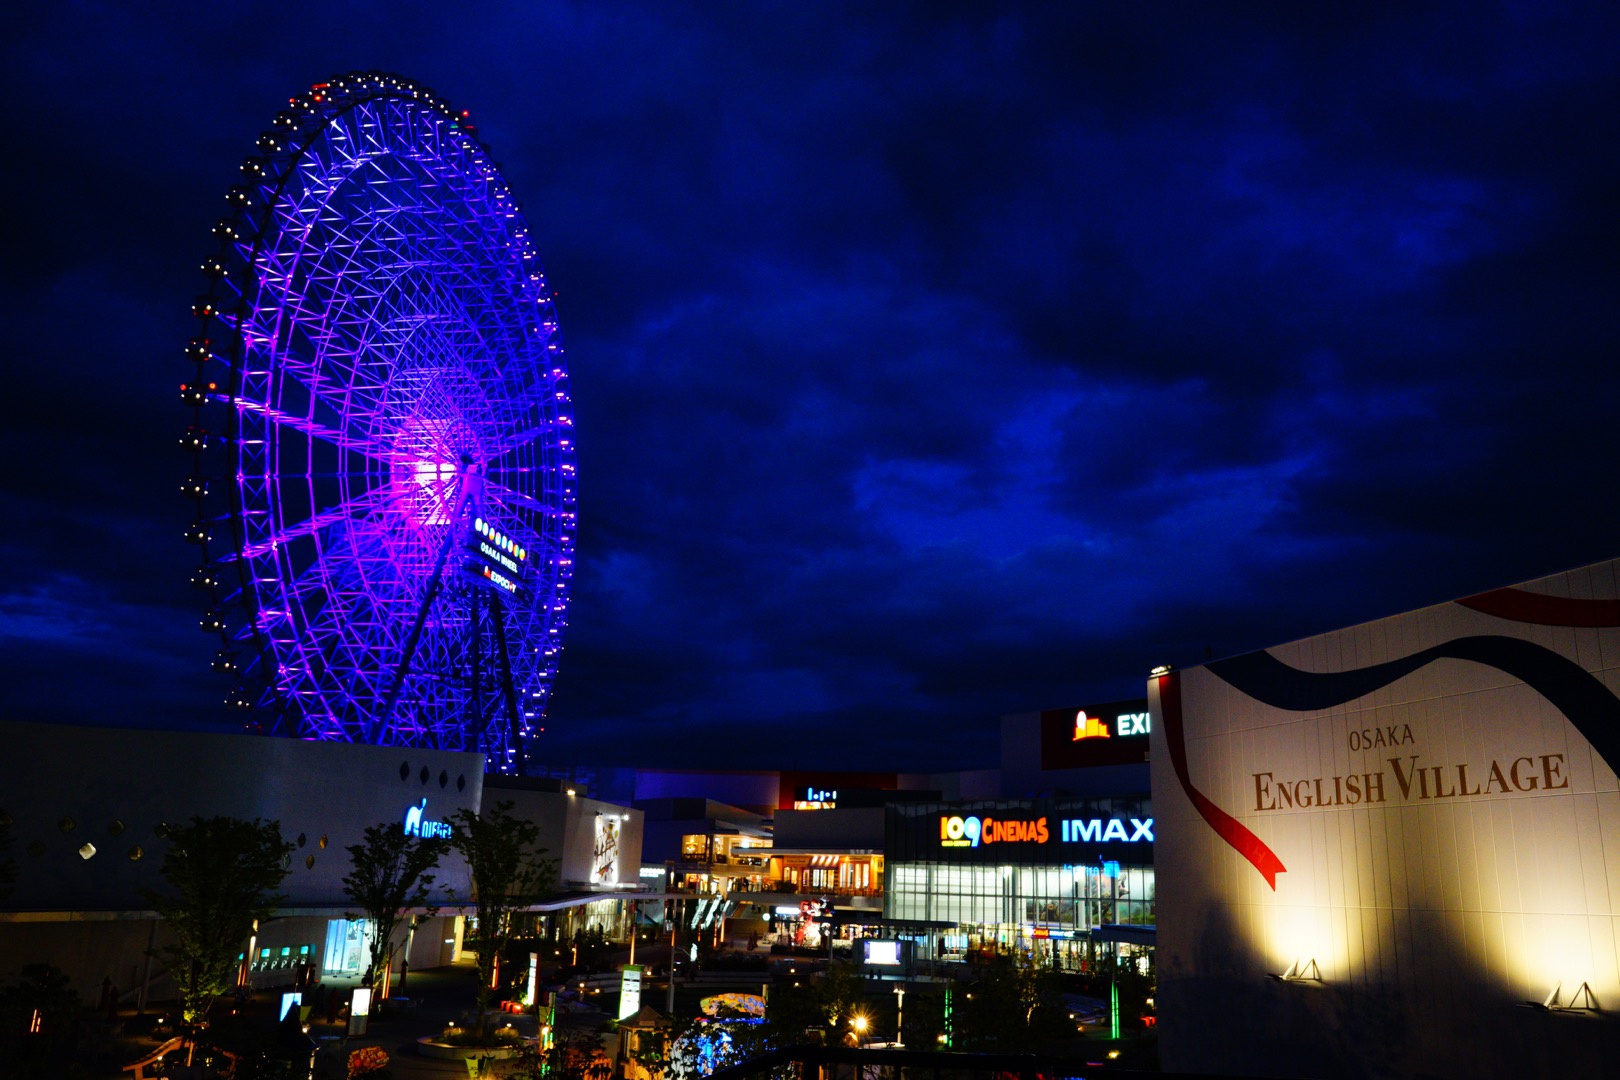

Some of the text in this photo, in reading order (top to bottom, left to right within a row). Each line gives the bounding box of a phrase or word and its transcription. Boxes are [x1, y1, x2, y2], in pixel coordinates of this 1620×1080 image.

[480, 542, 500, 562] OSAKA
[1349, 723, 1415, 752] OSAKA
[1252, 753, 1569, 811] ENGLISH VILLAGE
[940, 816, 1049, 848] 109 CINEMAS
[1062, 818, 1154, 842] IMAX
